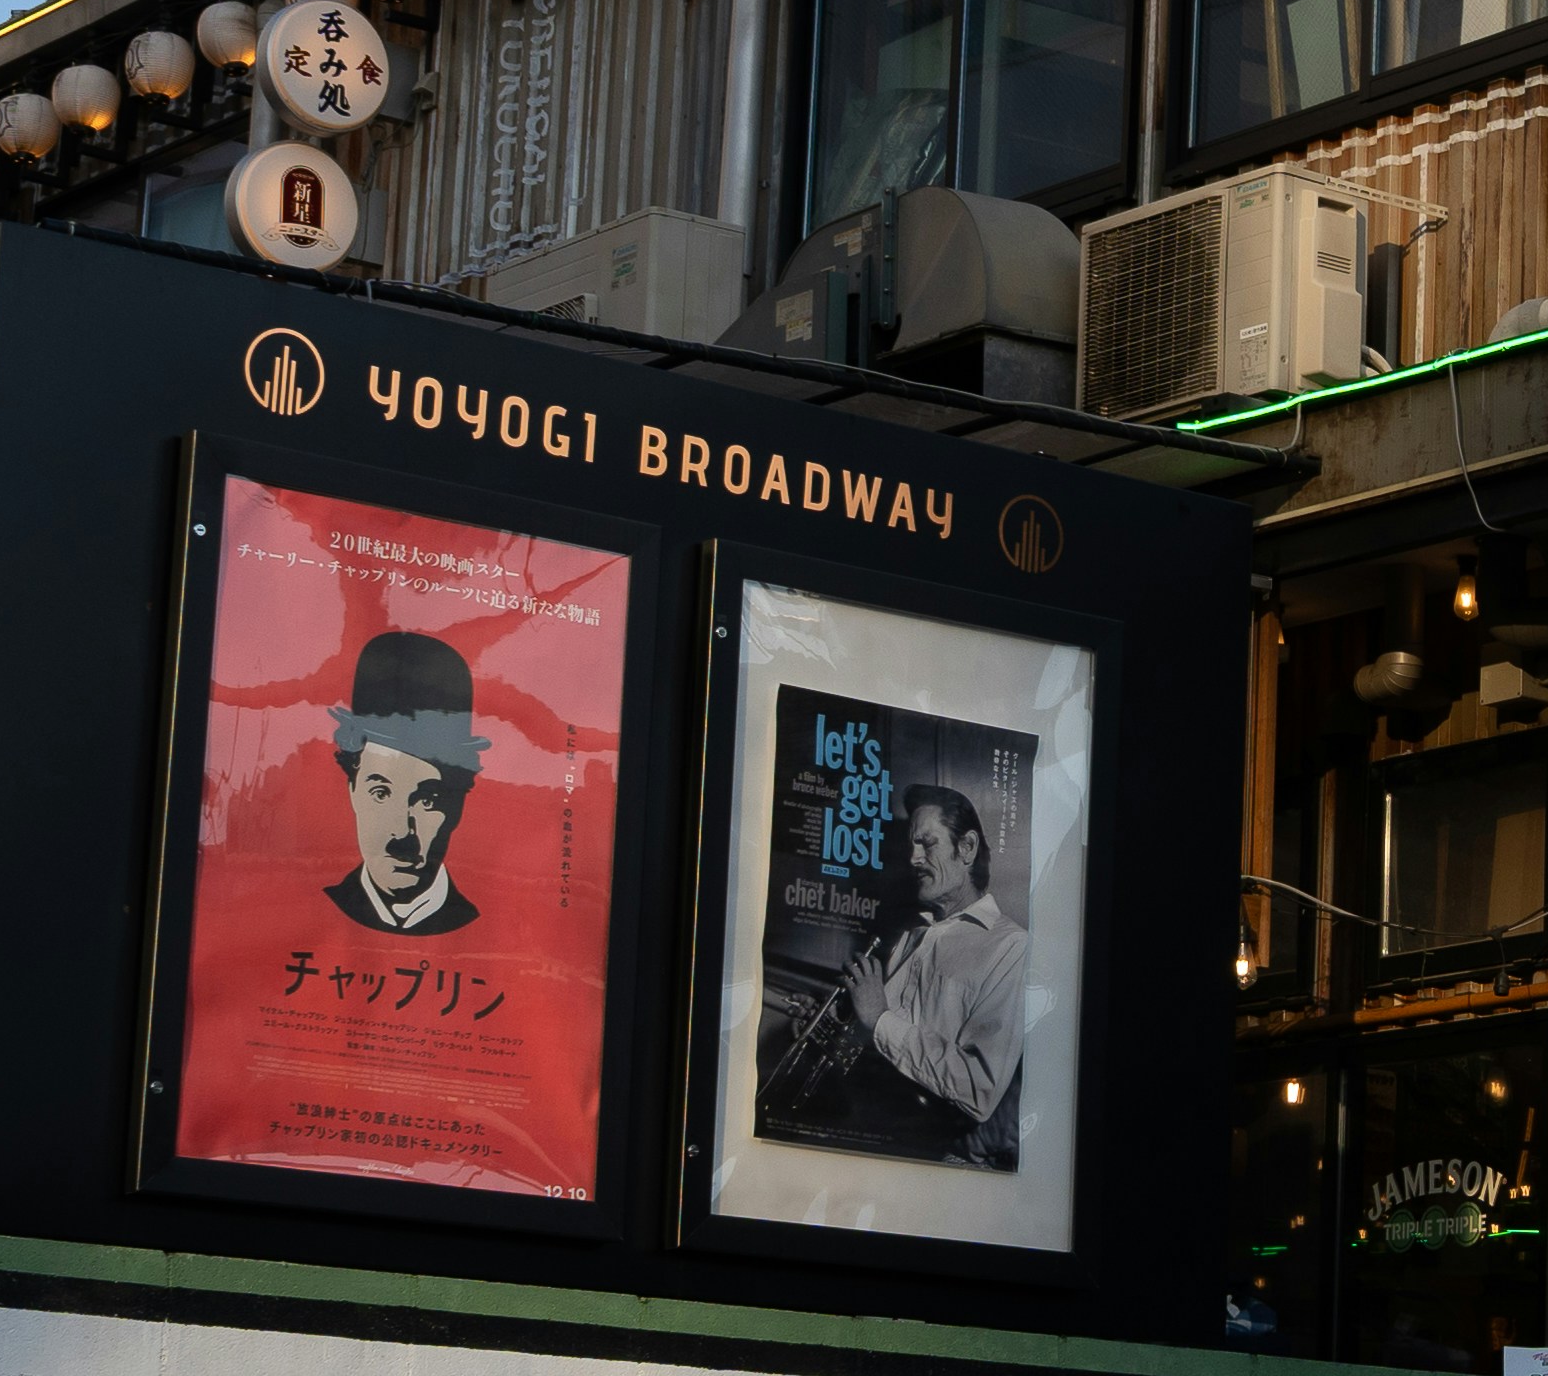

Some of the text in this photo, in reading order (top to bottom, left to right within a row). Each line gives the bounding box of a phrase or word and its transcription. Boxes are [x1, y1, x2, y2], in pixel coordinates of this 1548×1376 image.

[284, 10, 384, 117] 定 呑み処 食
[369, 365, 955, 539] YOYOGI BROADWAY
[236, 542, 602, 627] チャーリー・チャップリンのルーツに迫る新たな物語
[330, 530, 520, 581] 20世紀最大の映画スター
[792, 778, 839, 799] bruce weber
[804, 771, 817, 784] film
[839, 769, 894, 824] get
[822, 807, 885, 871] lost
[785, 877, 881, 920] chet baker
[284, 952, 505, 1021] チャップリン
[1368, 1158, 1504, 1221] JAMESON
[1383, 1213, 1488, 1241] TRIPLE TRIPLE
